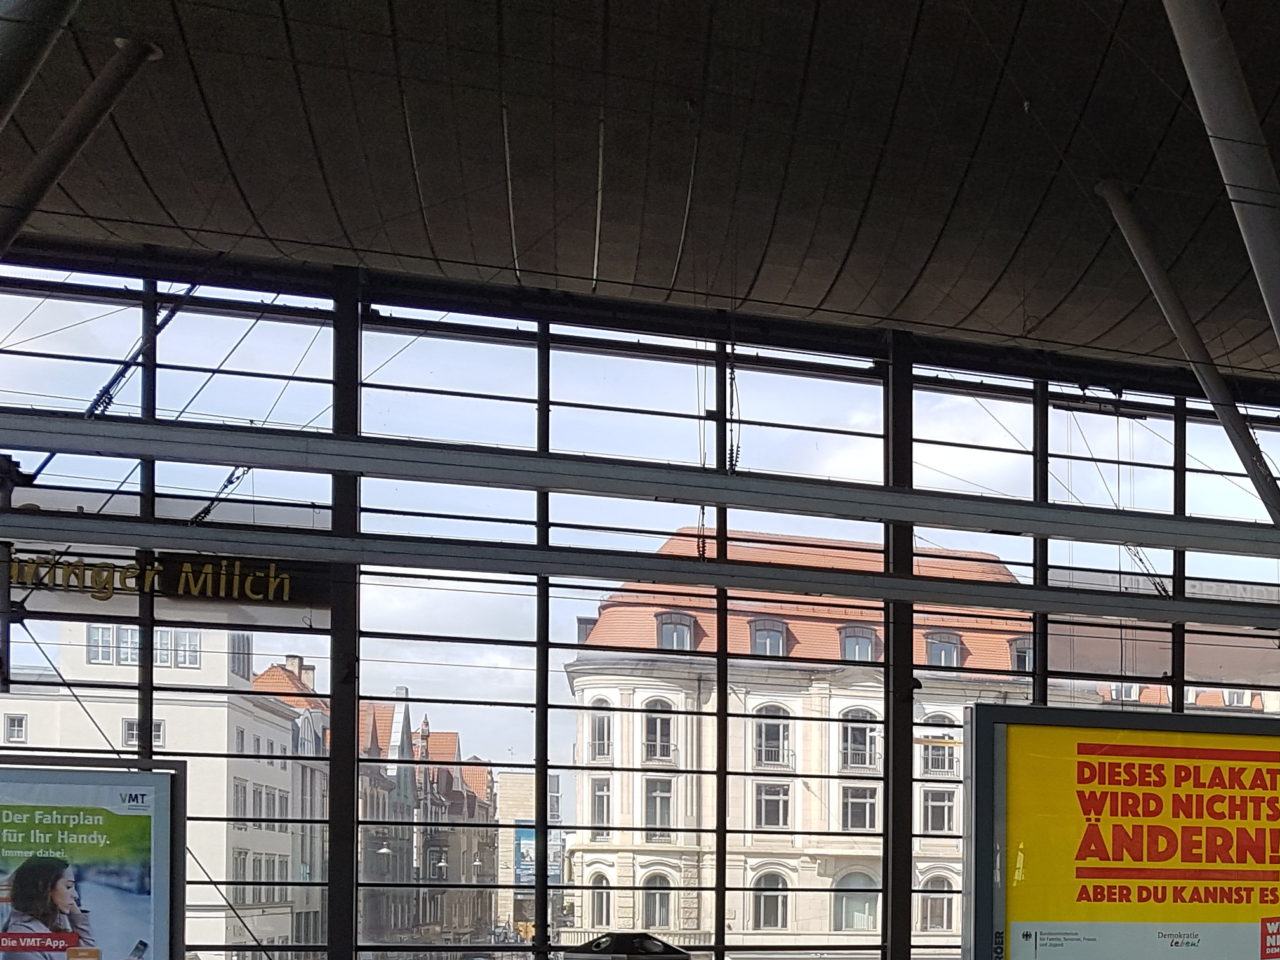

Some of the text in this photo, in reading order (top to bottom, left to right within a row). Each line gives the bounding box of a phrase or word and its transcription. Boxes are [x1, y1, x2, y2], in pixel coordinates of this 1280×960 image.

[177, 559, 291, 601] Milch
[1076, 760, 1167, 788] DIESES
[119, 793, 148, 804] VMT
[1075, 790, 1164, 818] WIRD
[2, 810, 104, 828] Der Fahrplan
[1, 828, 111, 848] für Ihr Handy.
[1, 848, 69, 859] Immer dabei.
[1075, 884, 1280, 905] ABER DU KANNST ES
[1, 937, 69, 949] Die VMT-App.
[1157, 931, 1199, 939] Demokratie
